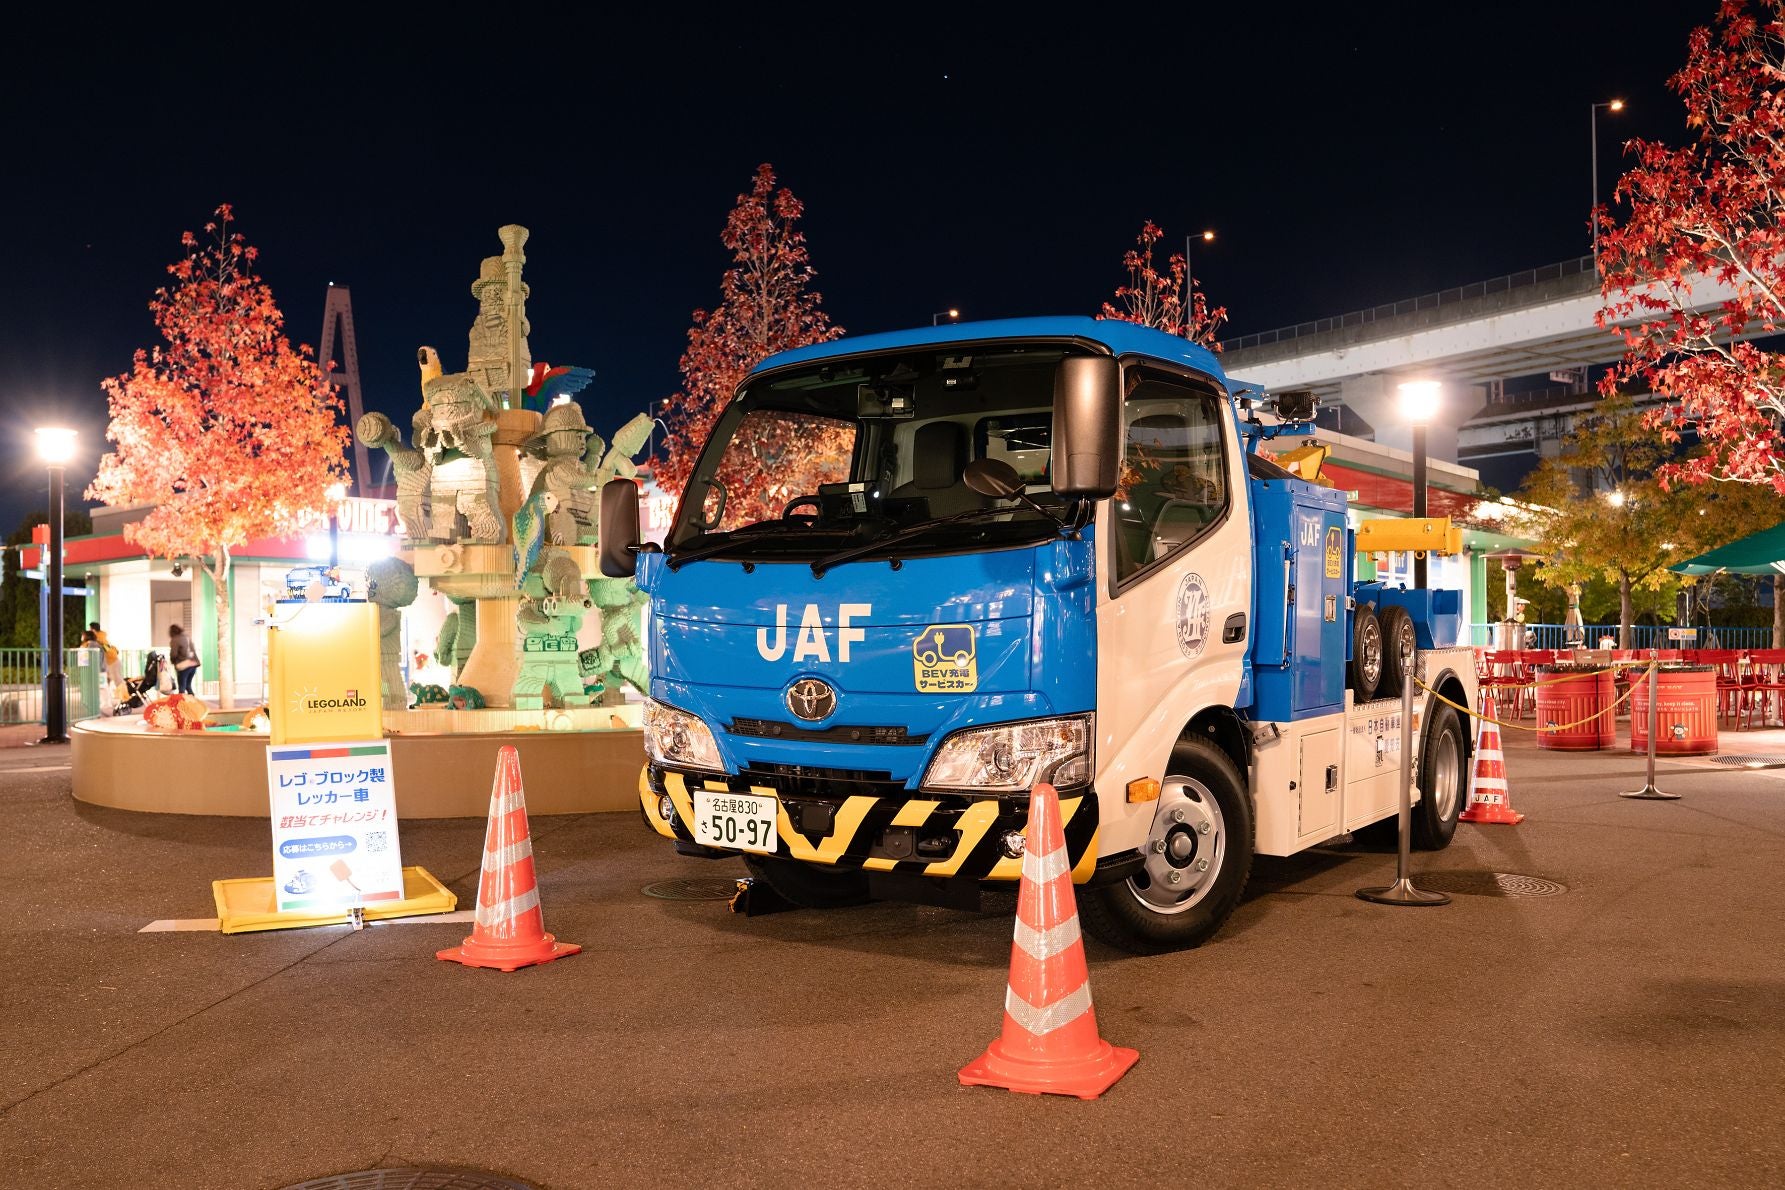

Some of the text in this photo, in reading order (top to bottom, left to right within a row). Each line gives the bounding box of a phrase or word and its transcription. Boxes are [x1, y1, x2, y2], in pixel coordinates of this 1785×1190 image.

[1301, 522, 1320, 547] JAF
[757, 604, 872, 662] JAF
[922, 669, 970, 678] BEV充電
[920, 680, 973, 689] サービスカー
[308, 689, 367, 709] LEGOLAND
[1368, 715, 1401, 735] 日本自動車連
[297, 788, 370, 806] レッカー車
[701, 815, 772, 847] さ 50-97
